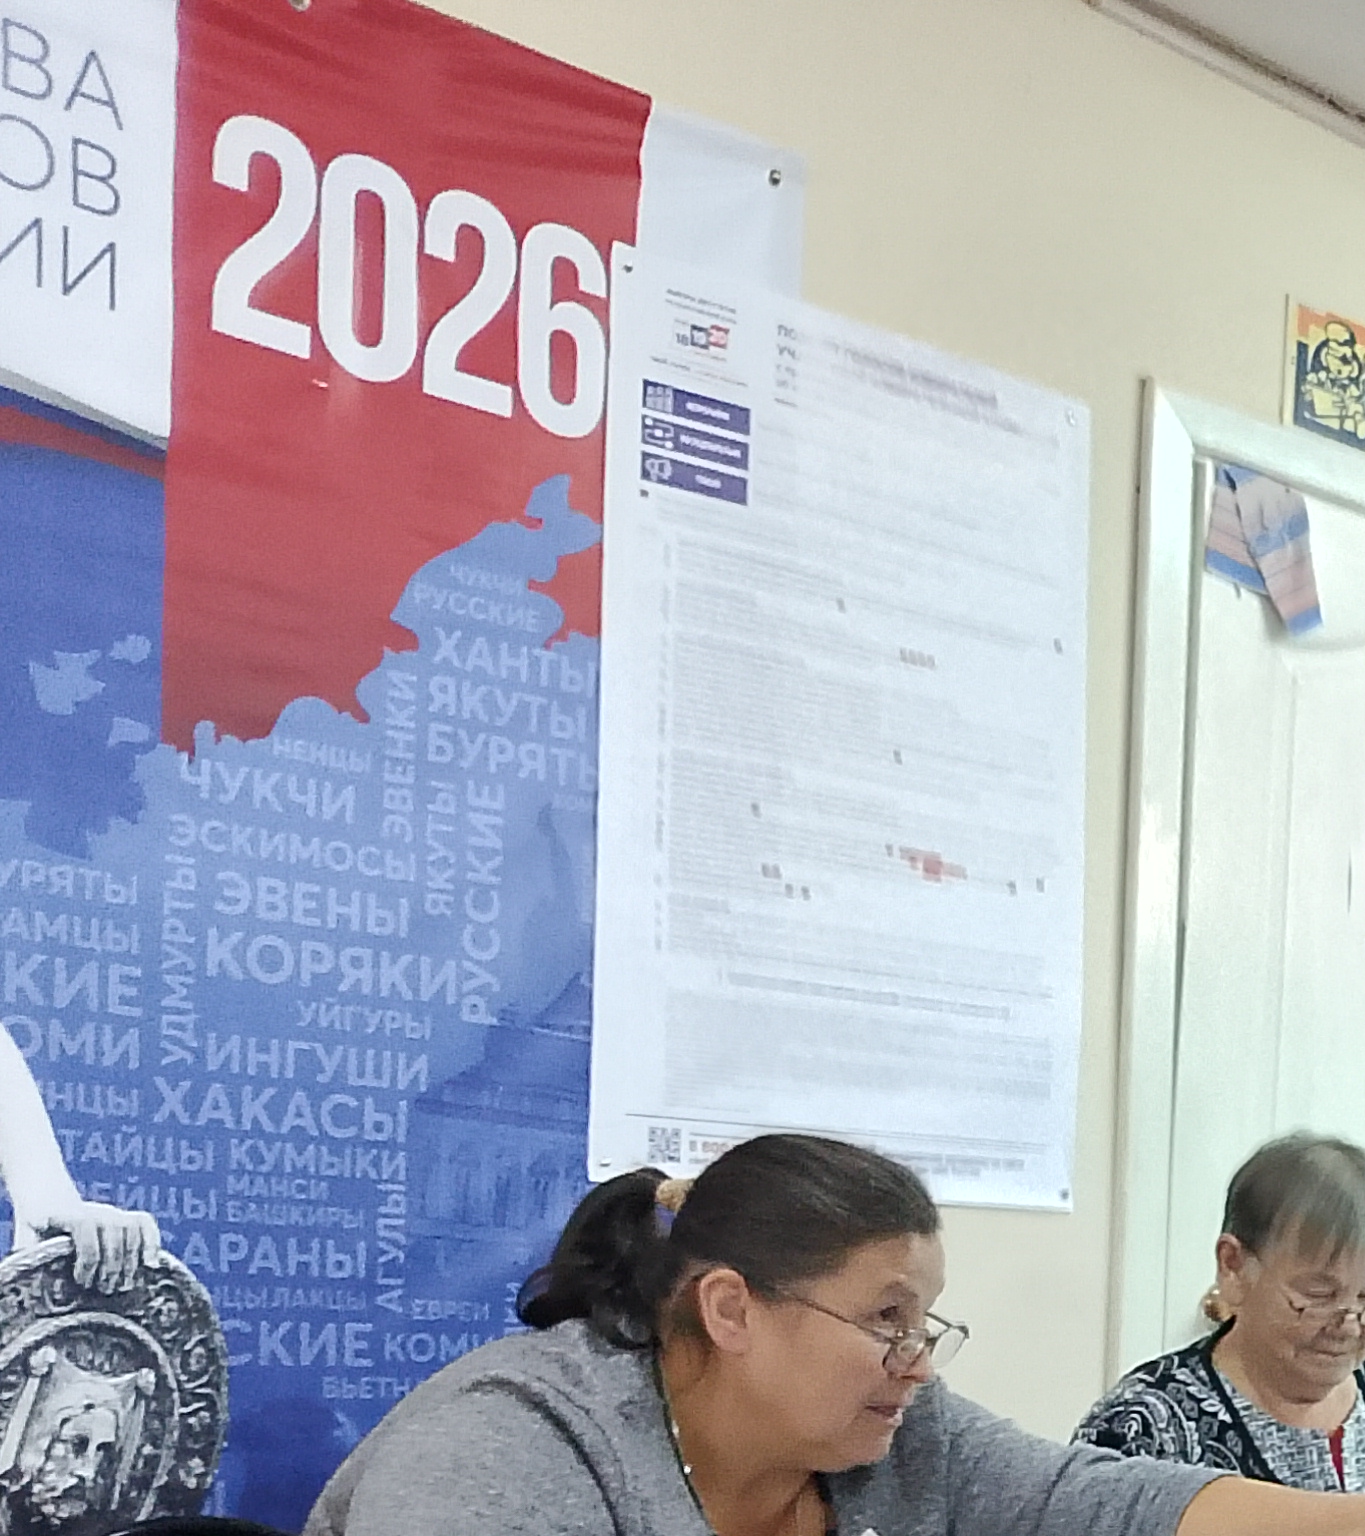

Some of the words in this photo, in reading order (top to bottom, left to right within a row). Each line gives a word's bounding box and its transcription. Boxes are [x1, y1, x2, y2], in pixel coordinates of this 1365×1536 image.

[2, 17, 123, 131] ВА
[0, 114, 120, 216] ОВ
[211, 113, 608, 438] 2026
[433, 626, 596, 699] ХАНТЫ
[428, 674, 587, 742] ЯКУТЫ
[178, 752, 356, 824] ЧУКЧИ
[380, 669, 418, 844] ЭВЕНКИ
[168, 813, 416, 882] ЭСКИМОСЫ
[424, 780, 456, 916] ЯКУТЫ
[213, 870, 410, 938] ЭВЕНЫ
[460, 779, 506, 1026] РУССКИЕ
[4, 948, 142, 1017] КИЕ
[160, 854, 199, 1066] УДМУРТЫ
[206, 926, 456, 1005] КОРЯКИ
[296, 997, 431, 1041] УЙГУРЫ
[206, 1032, 429, 1092] ИНГУШИ
[37, 1079, 139, 1119] НЦЫ
[152, 1075, 408, 1144] ХАКАСЫ
[58, 1124, 214, 1174] ТАЙЦЫ
[229, 1138, 406, 1181] КУМЫКИ
[76, 1176, 217, 1225] ЕЙЦЫ
[226, 1173, 330, 1200] МАНСИ
[161, 1229, 368, 1280] АРАНЫ
[375, 1183, 406, 1313] АГУЛЫ
